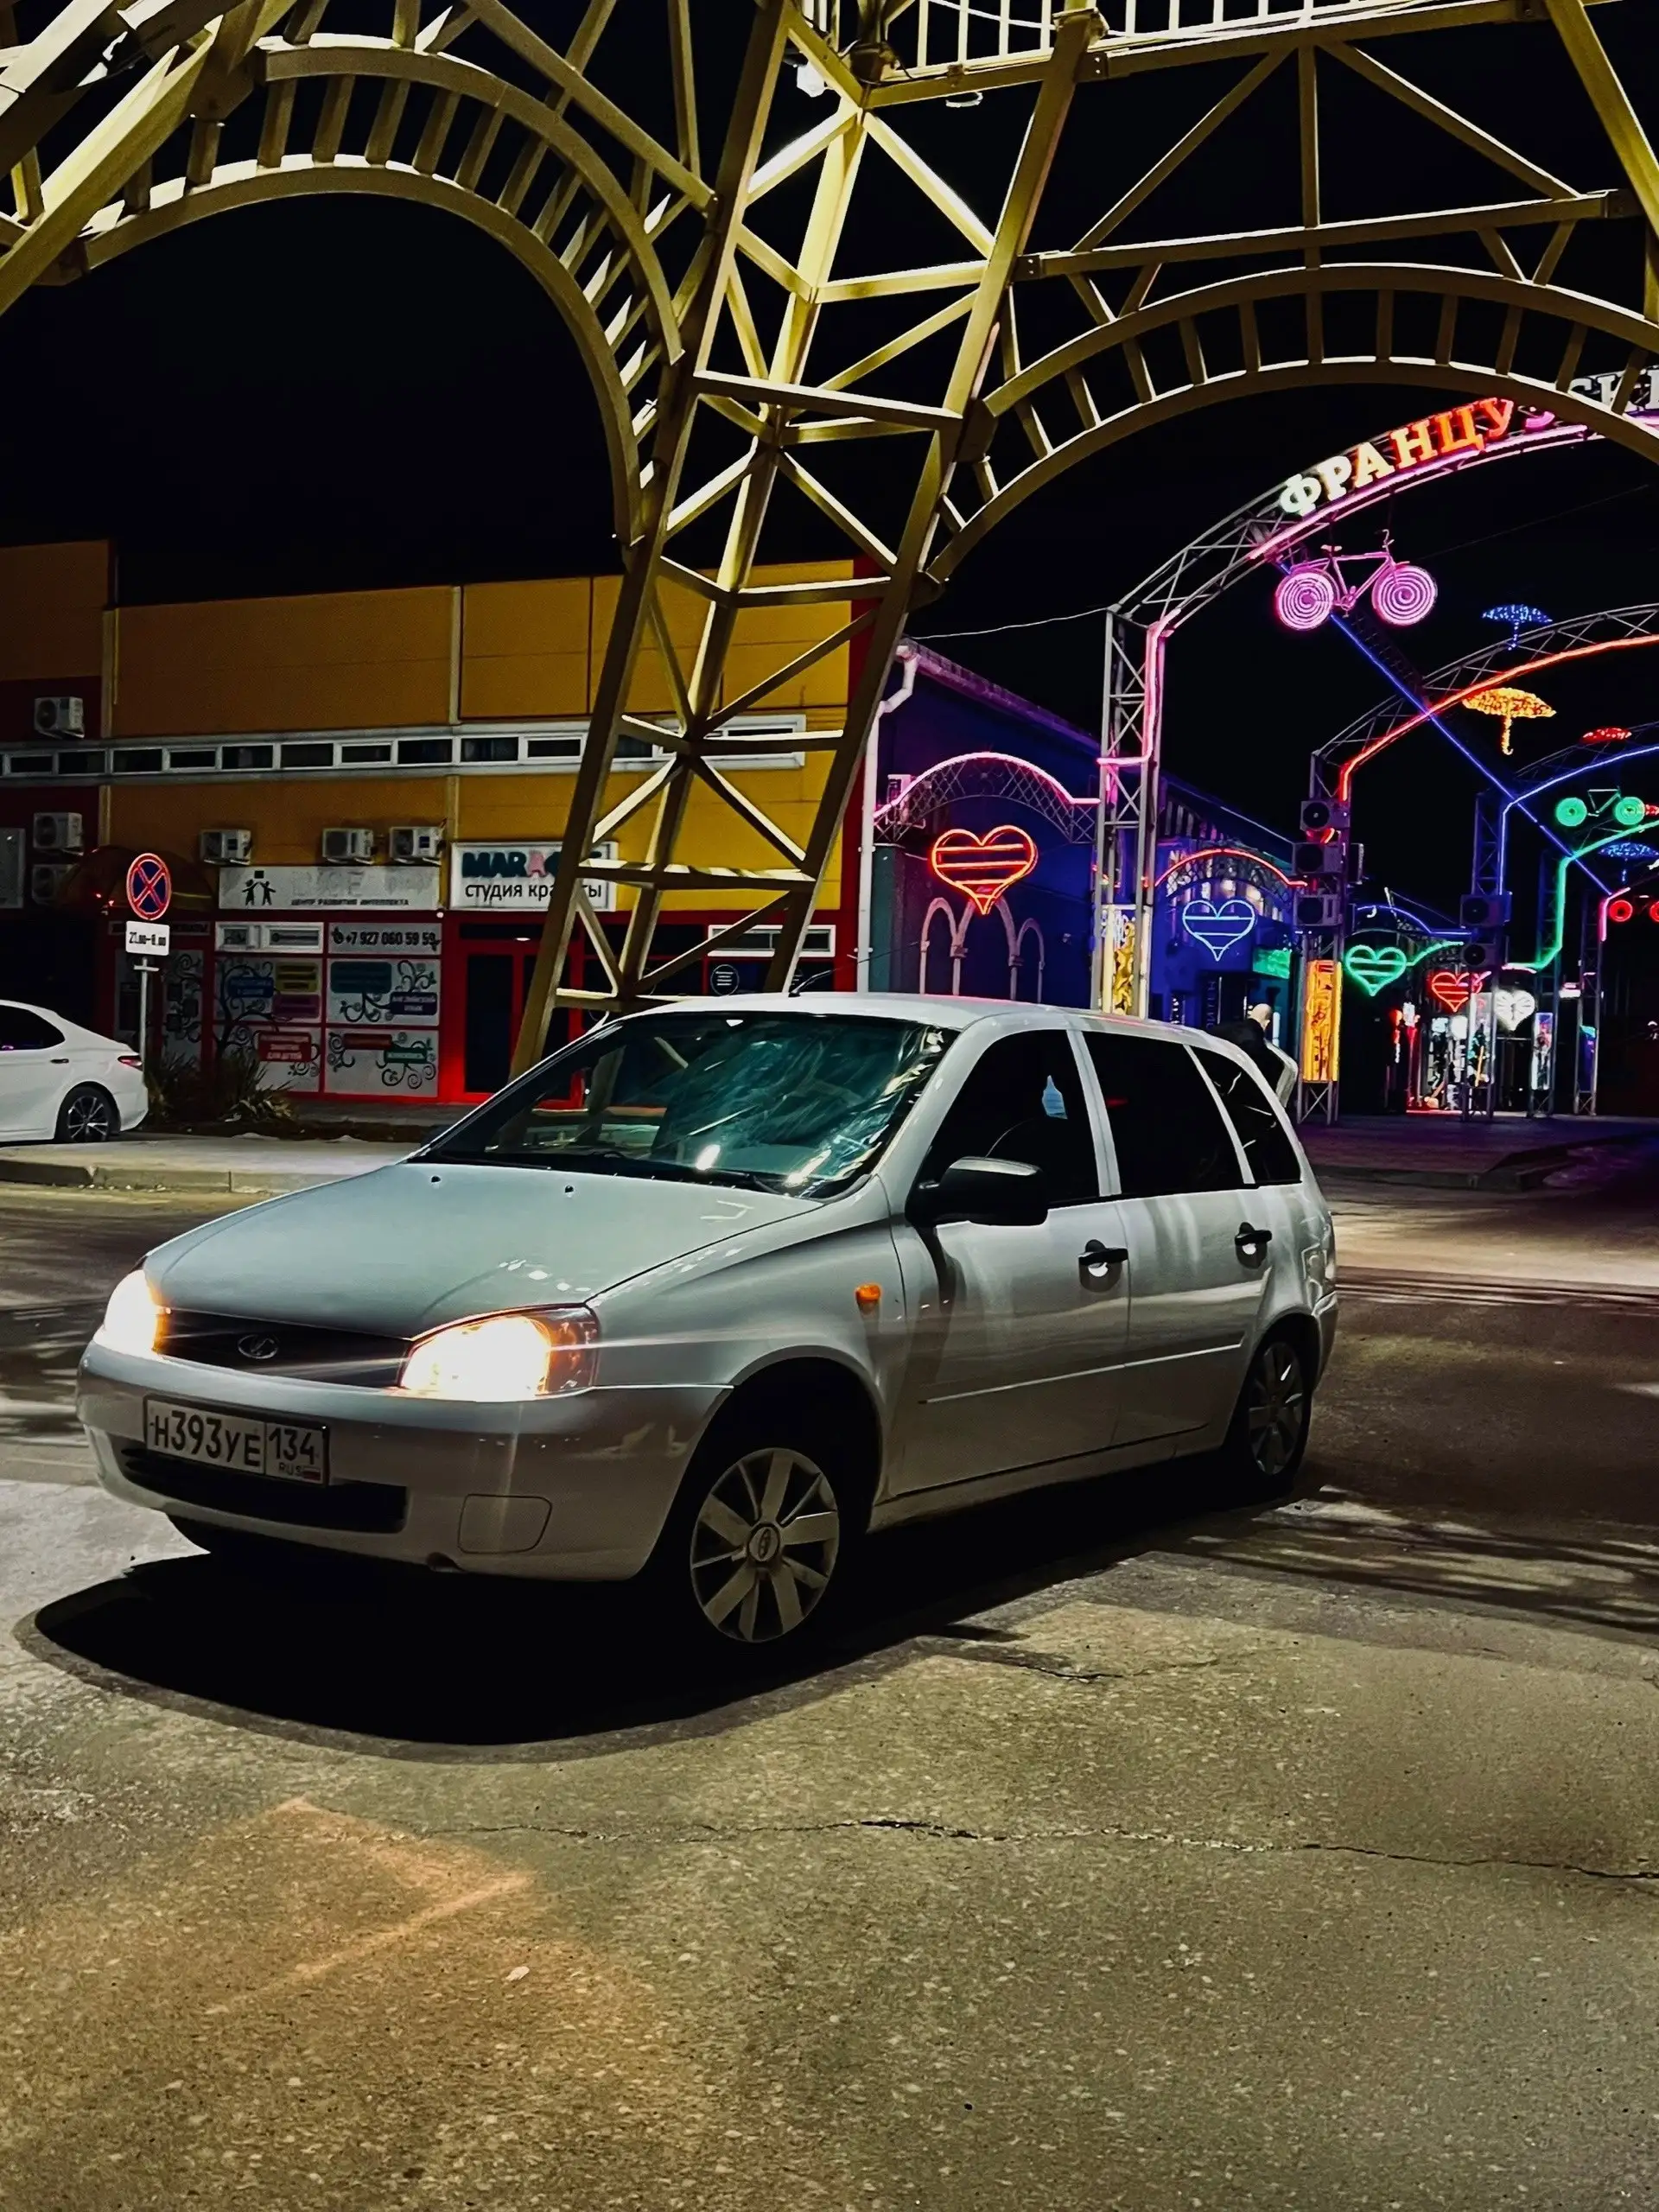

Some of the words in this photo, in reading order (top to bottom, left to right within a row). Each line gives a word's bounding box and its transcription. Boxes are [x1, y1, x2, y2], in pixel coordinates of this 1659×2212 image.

[465, 884, 523, 902] студия
[359, 931, 379, 946] 927
[404, 931, 420, 945] 59
[268, 1427, 315, 1465] 134
[278, 1462, 302, 1478] RUS
